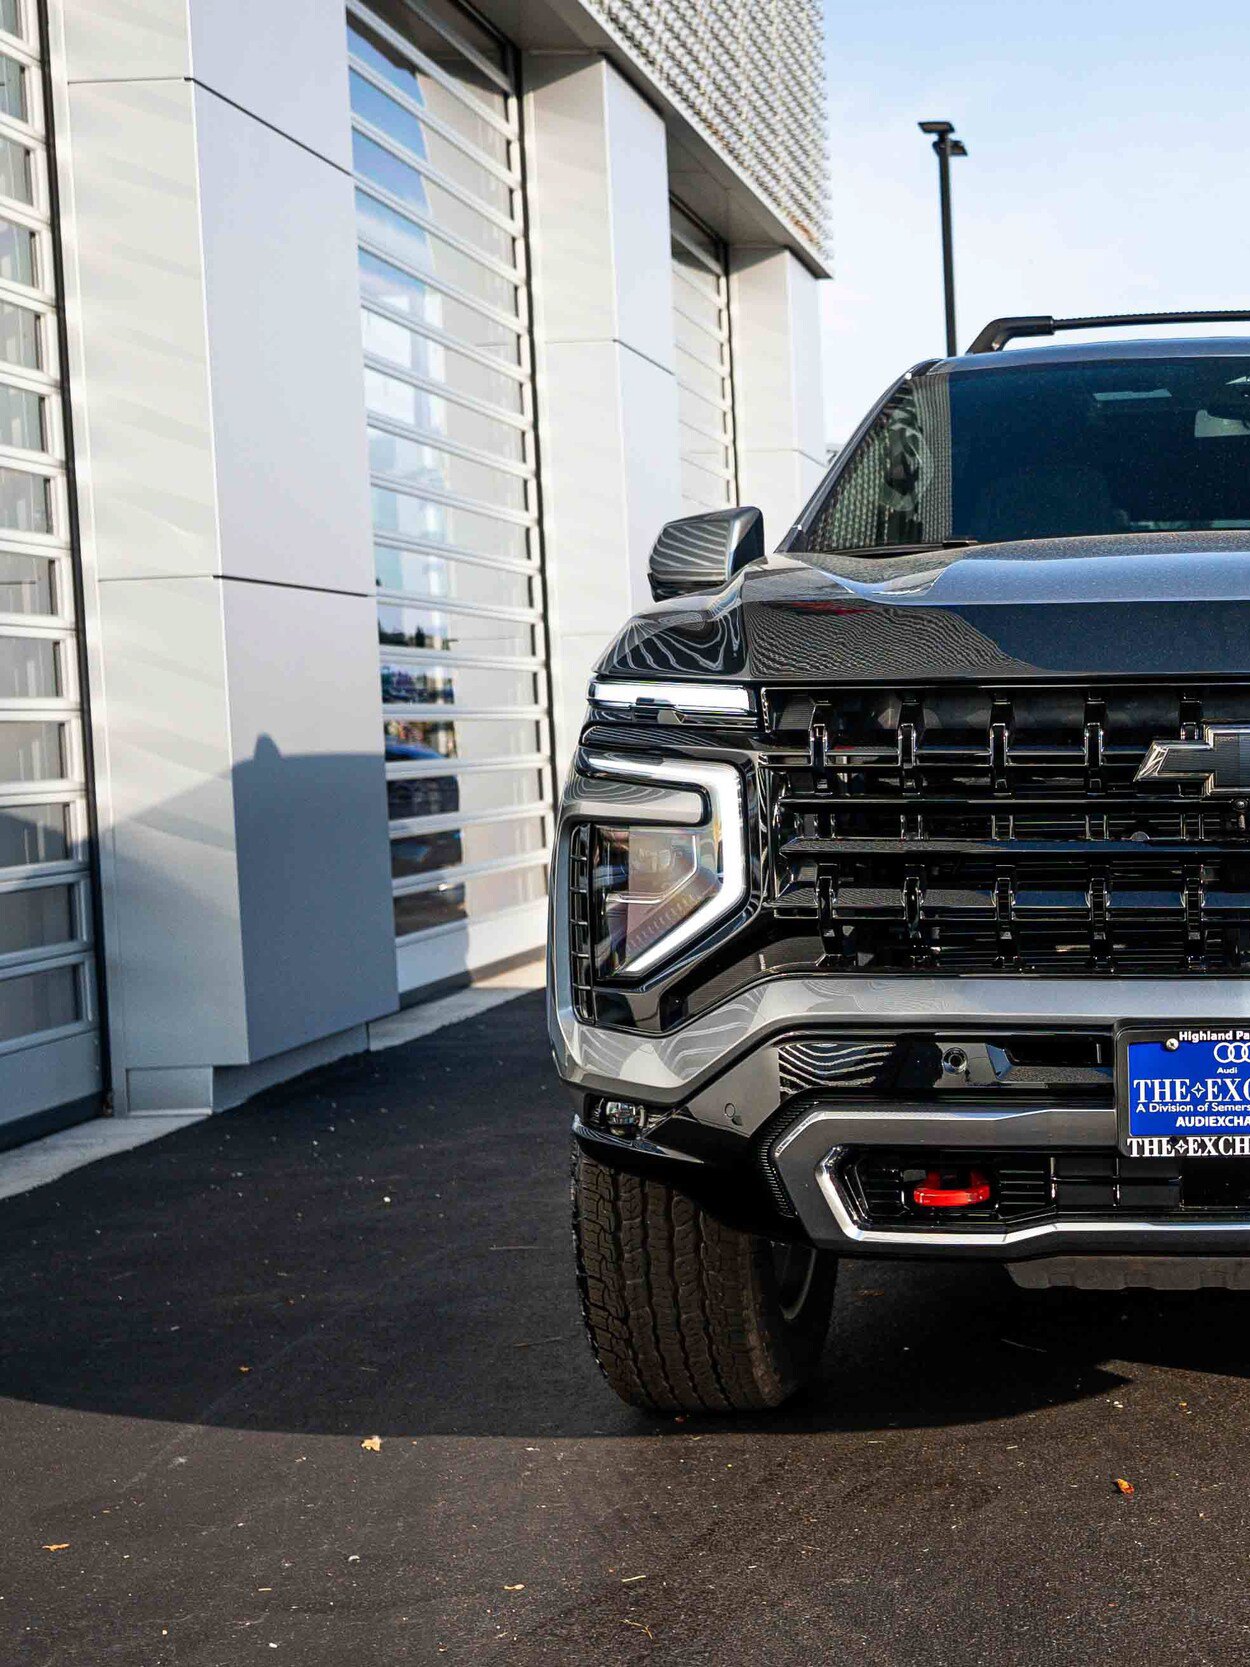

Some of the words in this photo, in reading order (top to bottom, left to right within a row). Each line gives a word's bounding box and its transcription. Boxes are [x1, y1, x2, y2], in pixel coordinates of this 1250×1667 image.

[1179, 1031, 1233, 1043] Highland
[1216, 1067, 1238, 1075] Audi
[1133, 1078, 1191, 1103] THE
[1136, 1104, 1146, 1113] A
[1149, 1103, 1194, 1113] Division
[1197, 1102, 1210, 1112] of
[1126, 1137, 1176, 1158] THE
